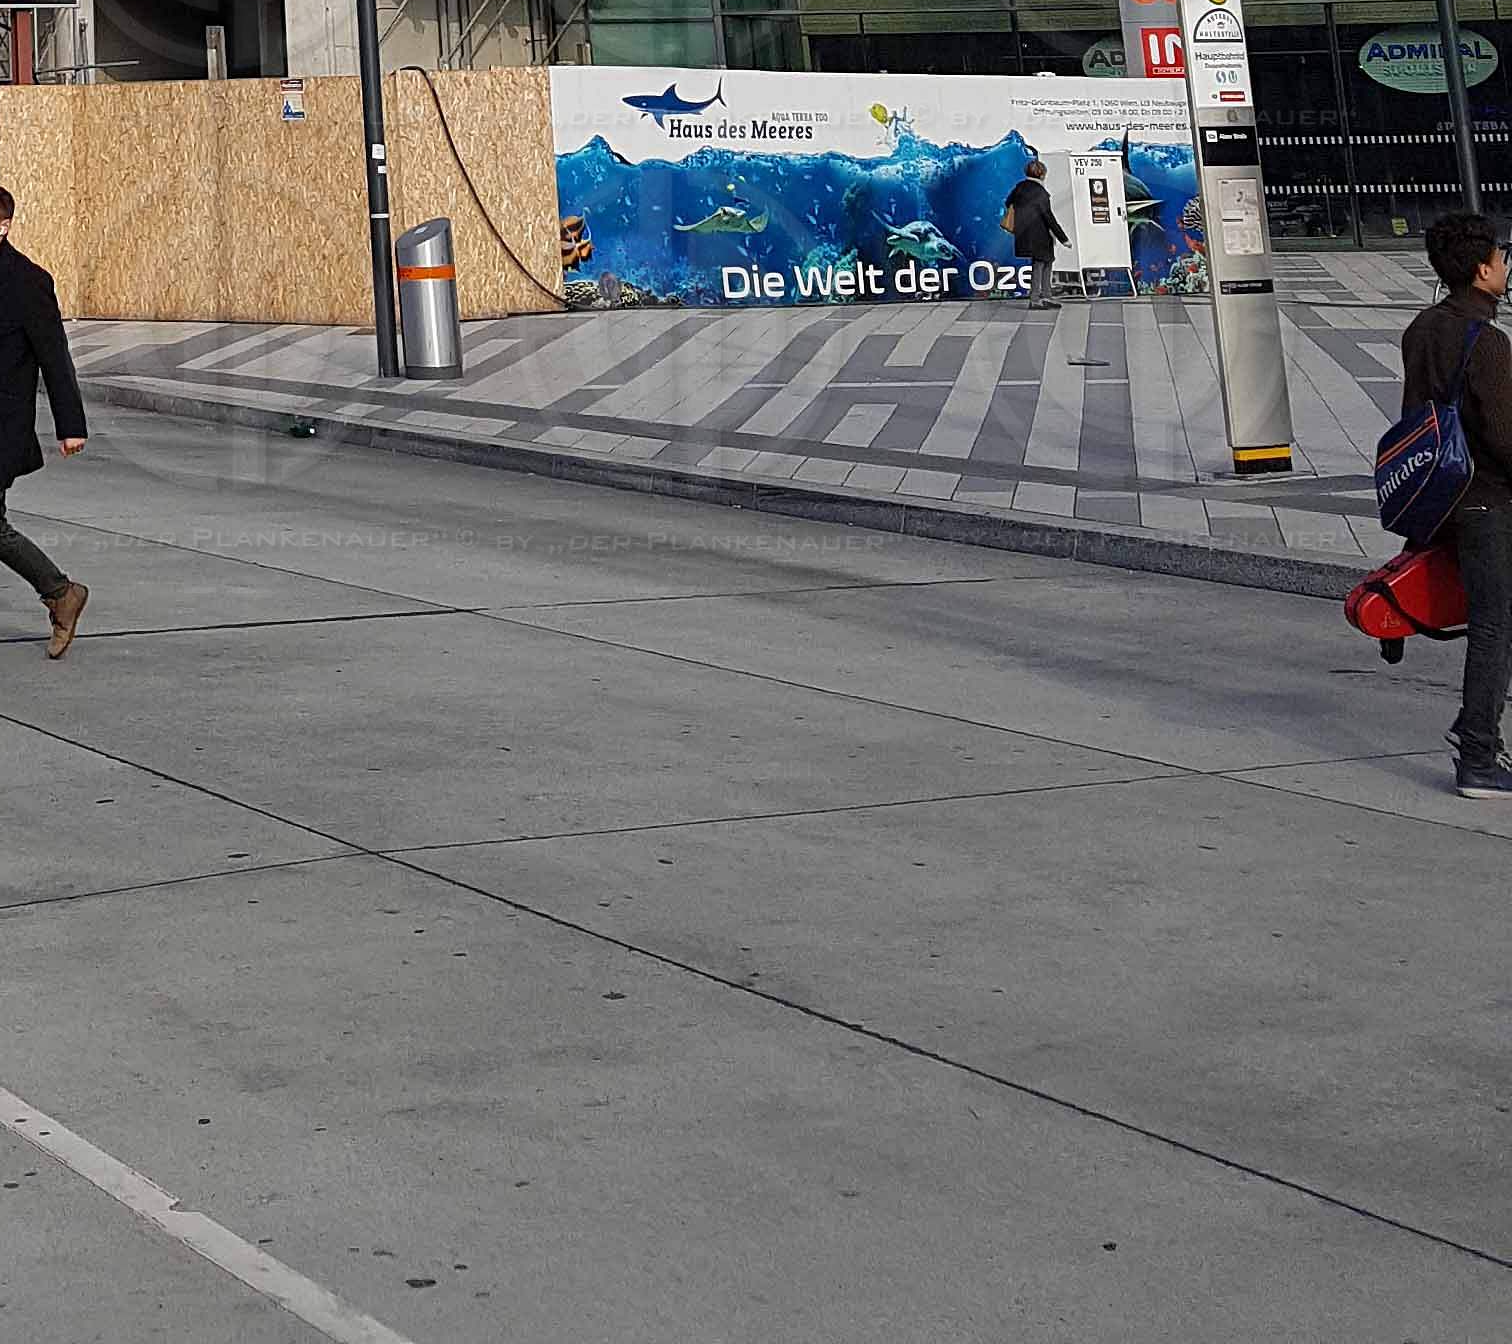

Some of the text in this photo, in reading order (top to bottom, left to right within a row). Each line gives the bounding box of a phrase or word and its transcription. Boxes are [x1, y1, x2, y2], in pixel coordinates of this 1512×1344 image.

[1366, 40, 1493, 62] ADMIAL
[668, 119, 813, 140] Haus des Meeres
[721, 261, 785, 300] Die
[799, 261, 884, 297] Welt
[894, 264, 959, 296] der
